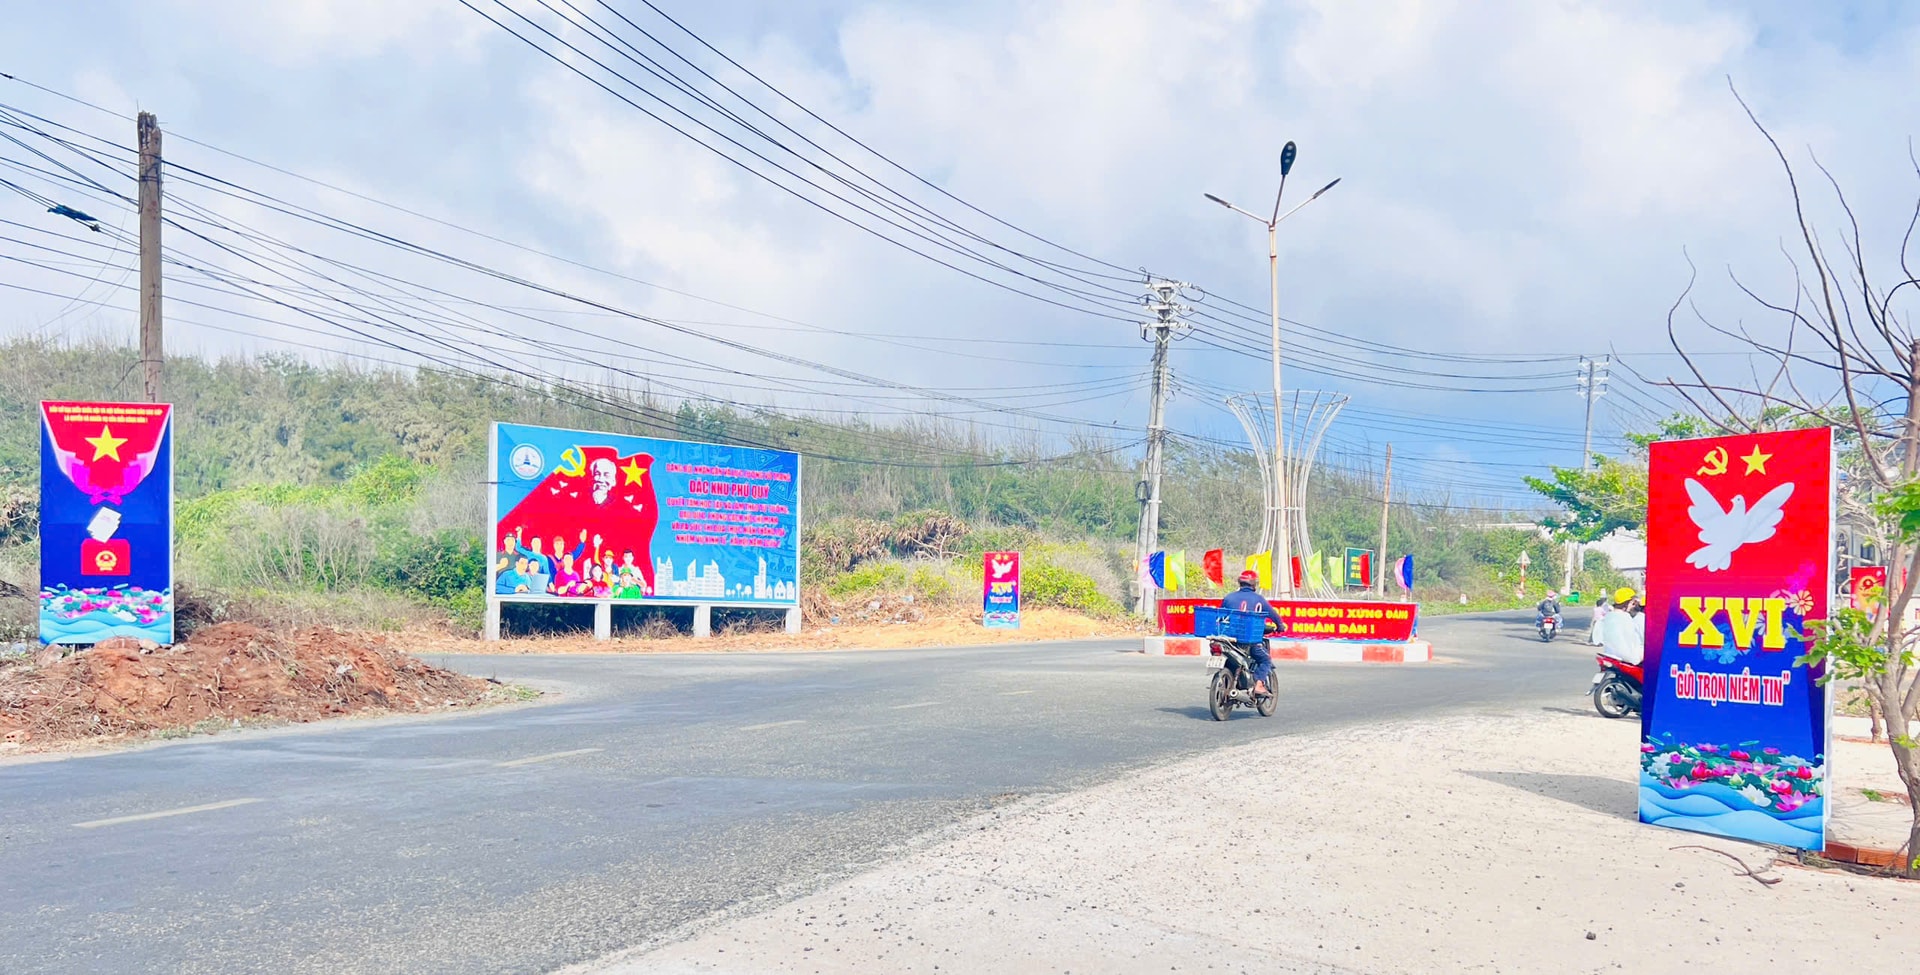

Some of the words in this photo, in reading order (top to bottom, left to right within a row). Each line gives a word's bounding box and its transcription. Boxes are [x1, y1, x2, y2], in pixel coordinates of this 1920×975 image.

[710, 481, 729, 496] KHU
[731, 480, 750, 498] PHÚ
[752, 483, 770, 499] QUÝ
[1296, 606, 1344, 618] NGƯỜI
[1347, 608, 1384, 618] XỨNG
[1292, 622, 1335, 632] NHÂN
[1339, 622, 1367, 634] DÂN
[1678, 596, 1787, 652] XVI
[1697, 672, 1727, 707] TRỌN
[1729, 667, 1760, 704] NIỀM
